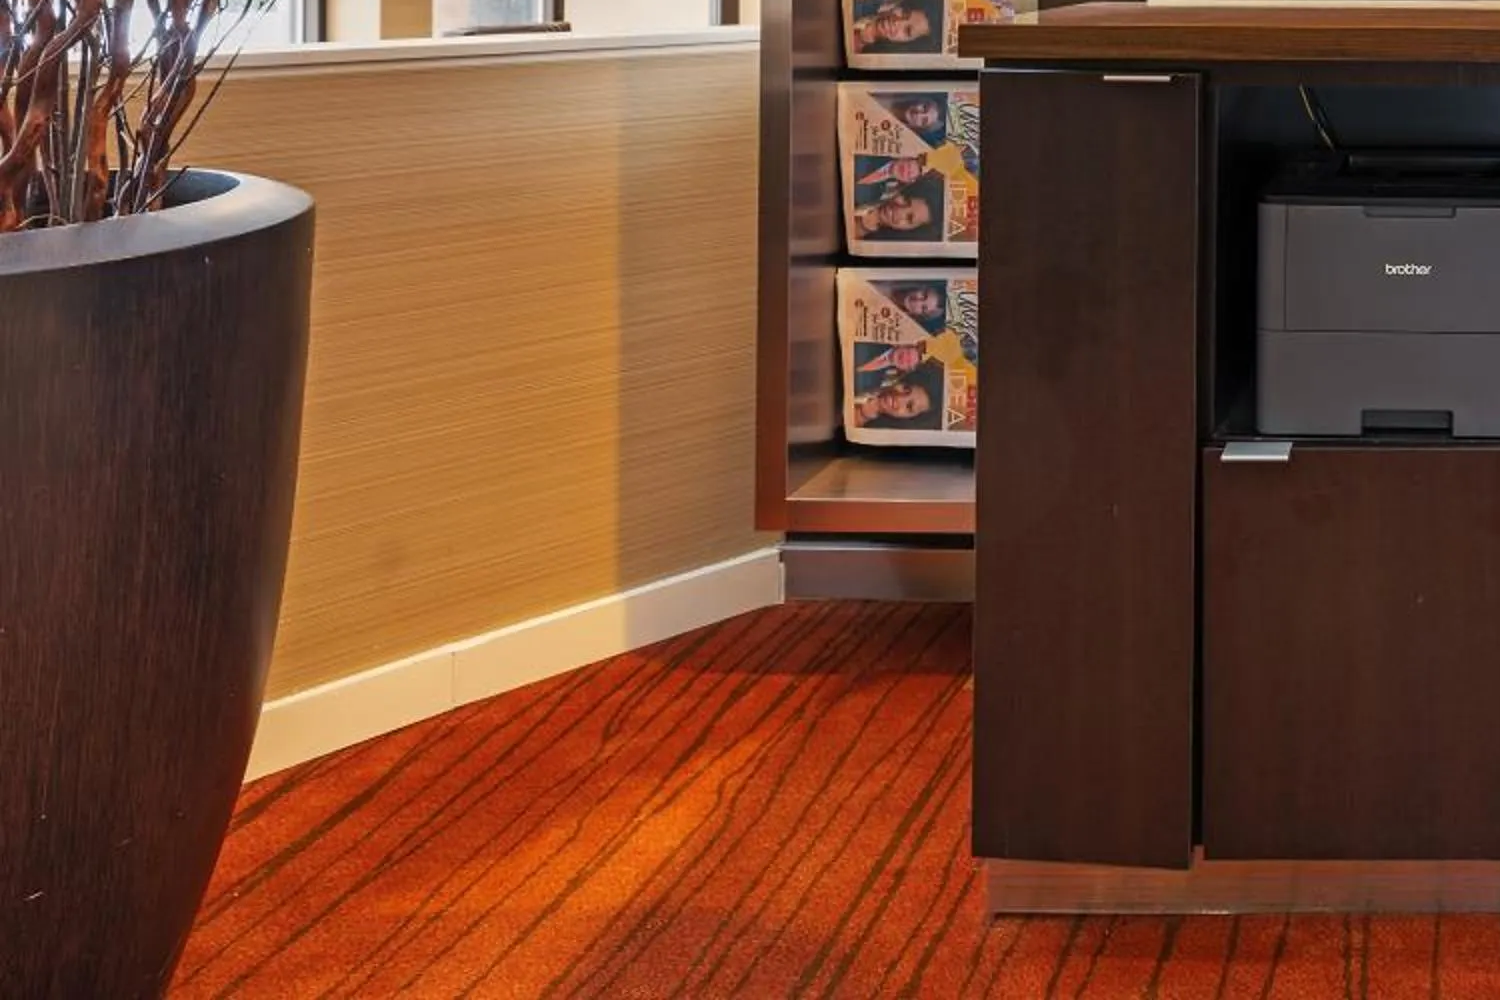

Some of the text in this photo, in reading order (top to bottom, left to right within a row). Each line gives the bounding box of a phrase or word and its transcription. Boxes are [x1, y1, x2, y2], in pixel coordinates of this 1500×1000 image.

[947, 180, 967, 237] IDEA
[1385, 263, 1432, 275] brother
[946, 368, 967, 426] IDEA
